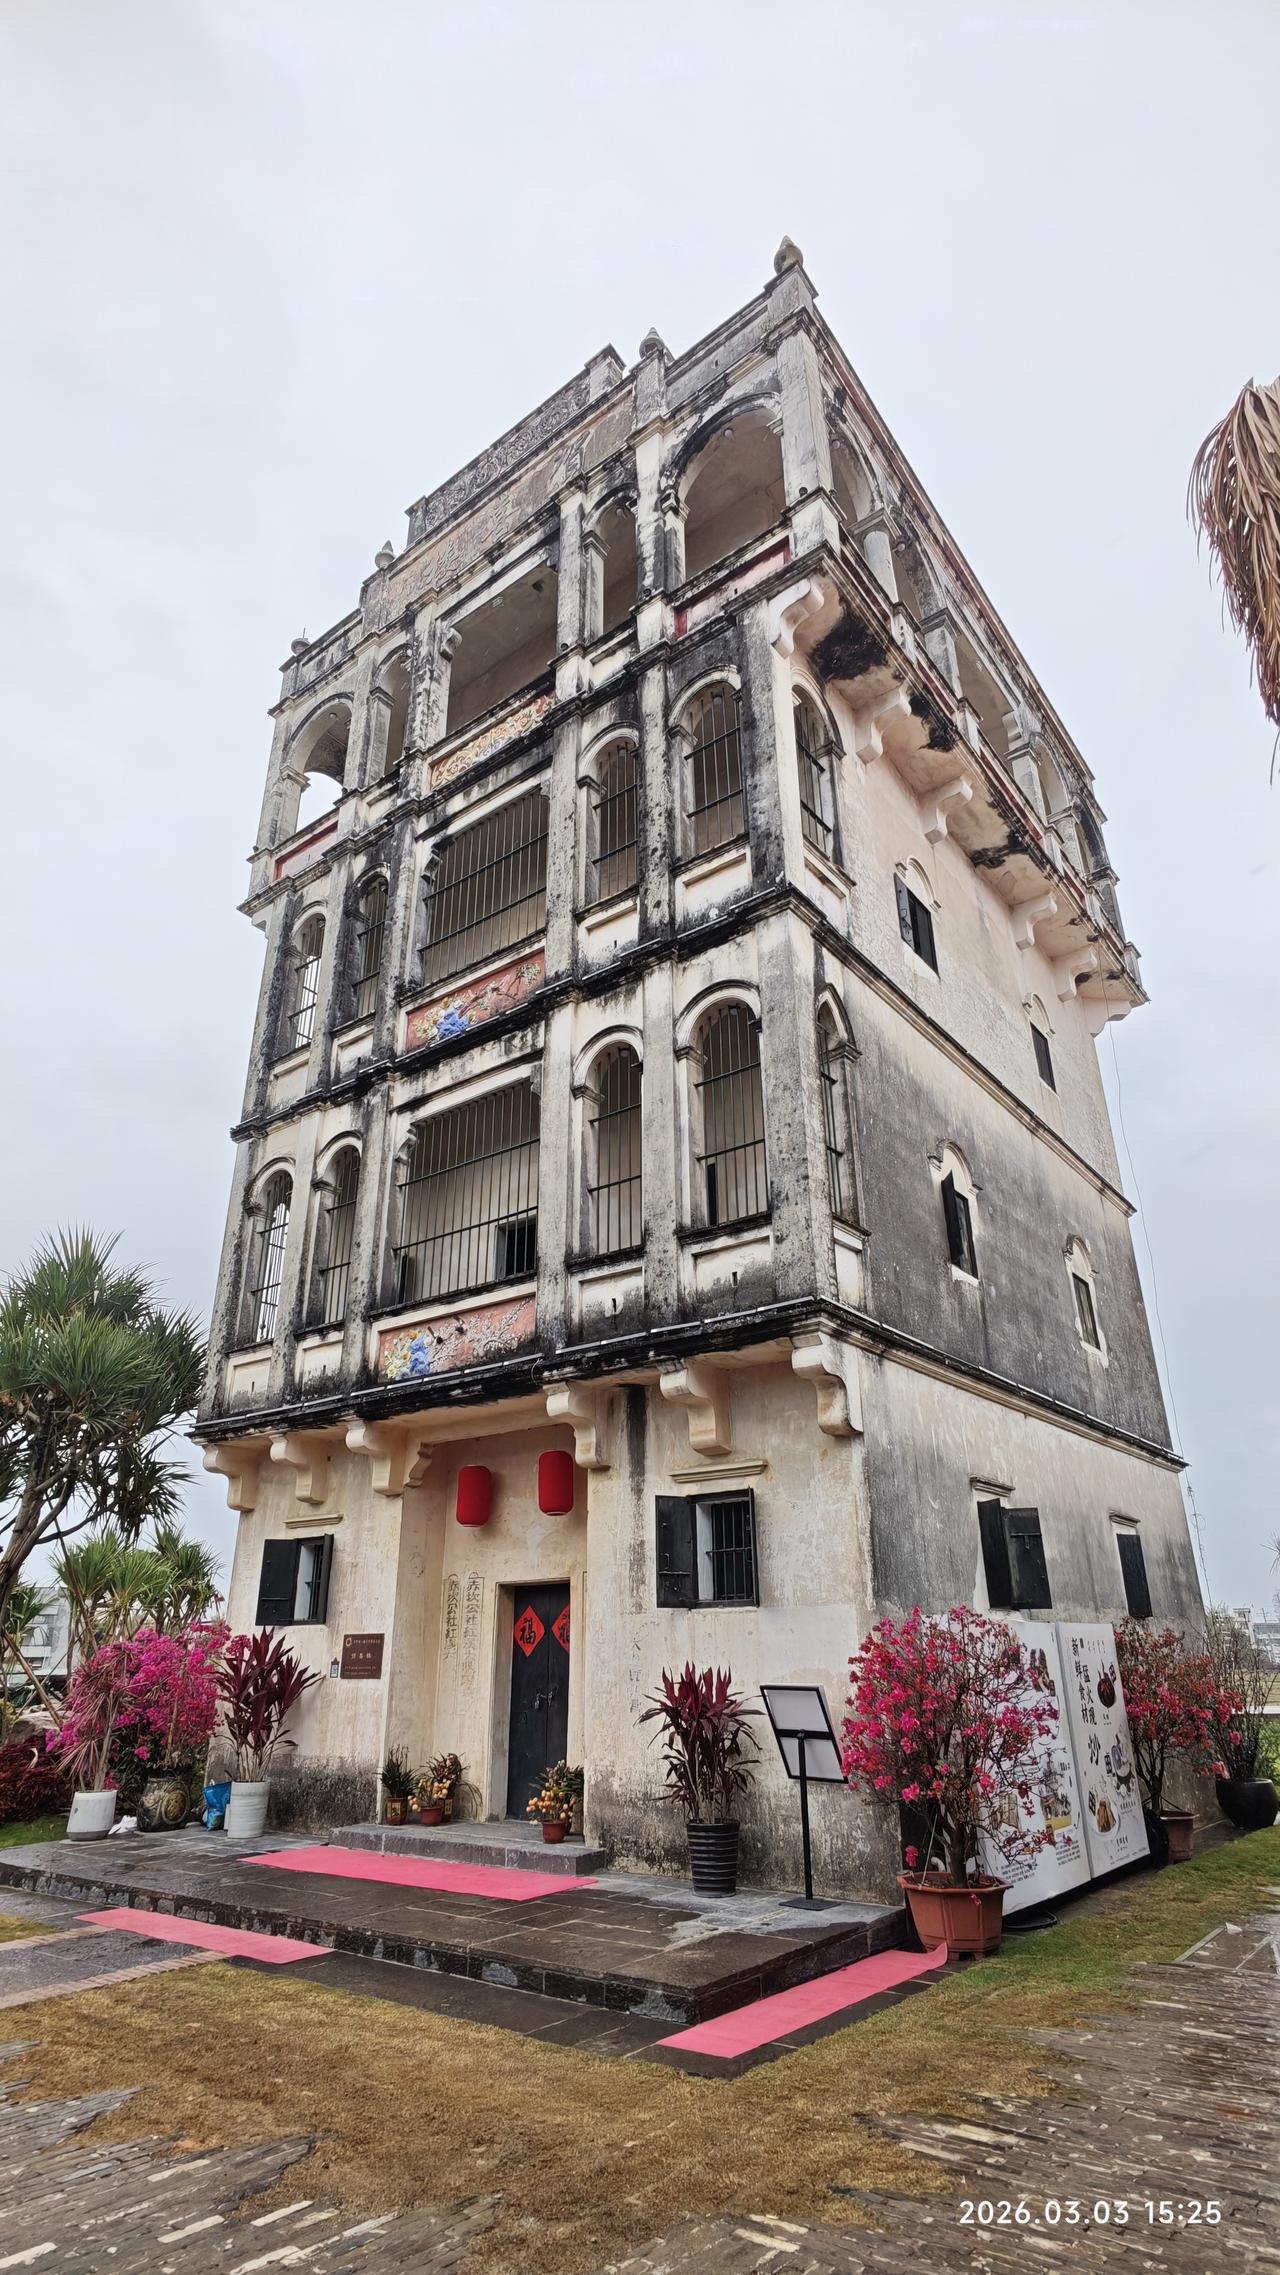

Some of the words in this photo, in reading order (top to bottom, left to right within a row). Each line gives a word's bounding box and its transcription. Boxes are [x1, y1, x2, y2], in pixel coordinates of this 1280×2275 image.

[520, 1617, 536, 1644] 福
[1072, 1637, 1089, 1724] 新鲜食材
